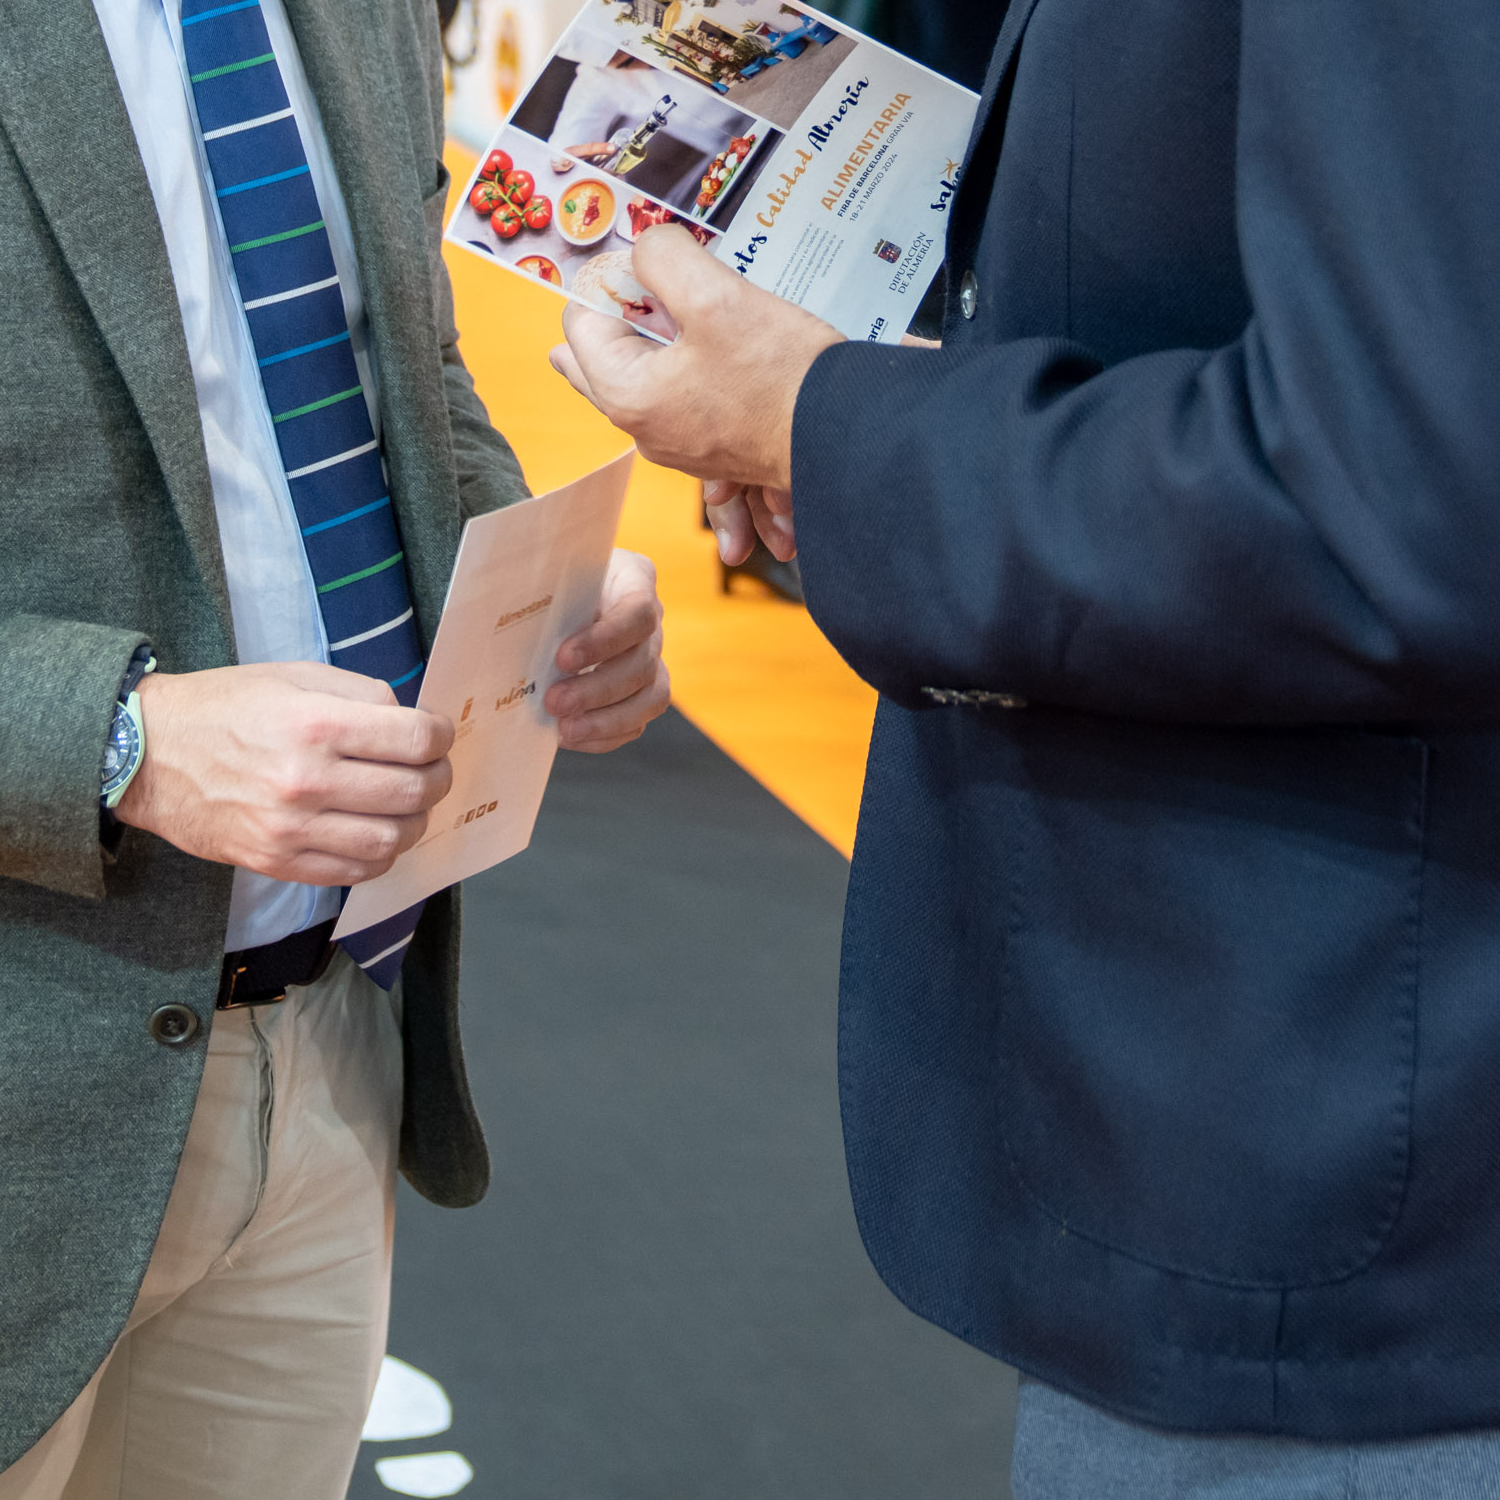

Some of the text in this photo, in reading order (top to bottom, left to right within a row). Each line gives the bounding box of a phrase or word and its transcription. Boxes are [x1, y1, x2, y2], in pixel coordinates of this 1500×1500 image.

[756, 149, 813, 228] Calidad
[807, 76, 870, 152] Almería
[820, 92, 912, 211] ALIMENTARIA
[837, 110, 915, 218] FIRA DE BARCELONA GRAN VIA
[849, 152, 898, 222] 18-21 MARZO 2024
[889, 231, 926, 292] DIPUTACIÓN
[897, 238, 934, 294] DE ALMERÍA
